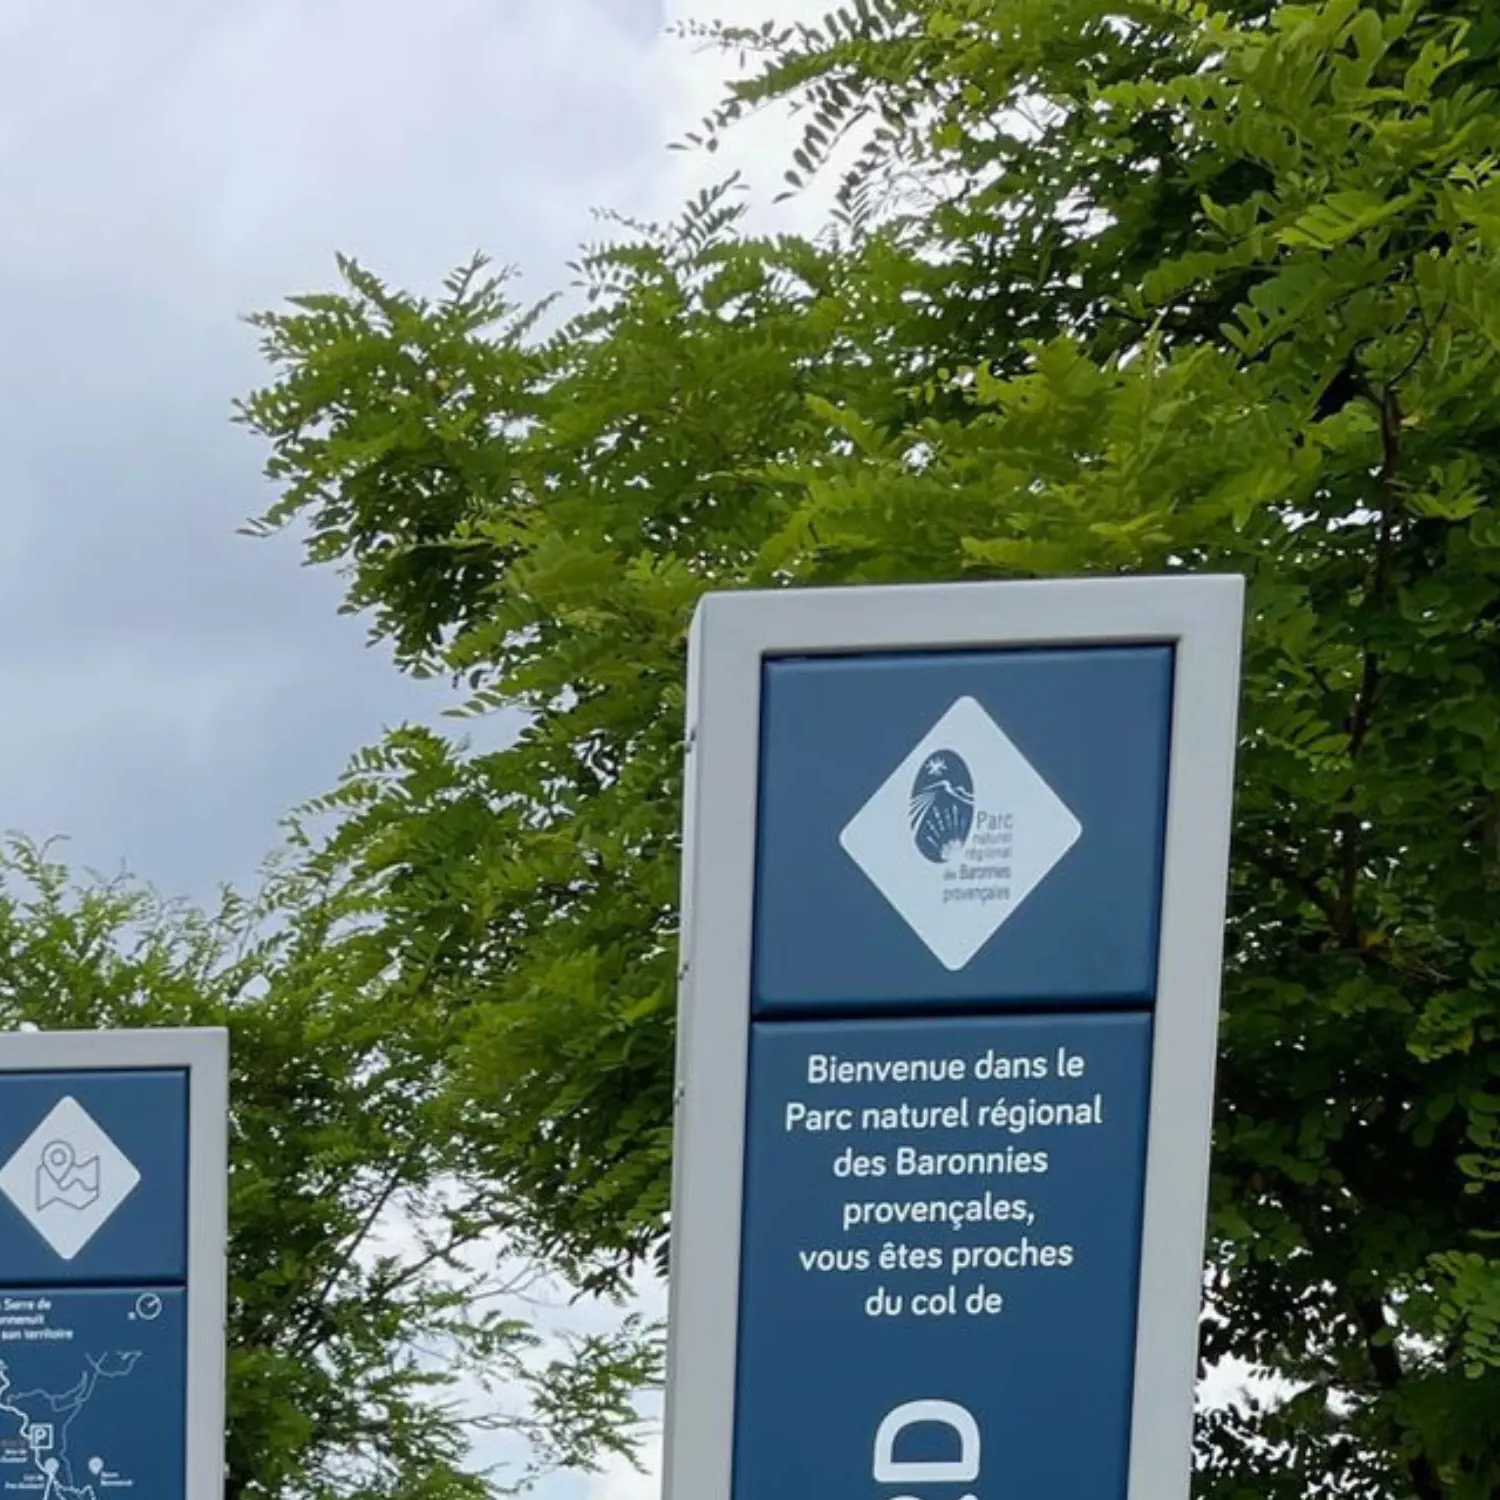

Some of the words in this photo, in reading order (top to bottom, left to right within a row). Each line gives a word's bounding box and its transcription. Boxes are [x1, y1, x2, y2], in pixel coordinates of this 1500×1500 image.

[977, 811, 1013, 830] Parc
[806, 1053, 967, 1084] Bienvenue
[974, 1049, 1048, 1079] dans
[1057, 1047, 1086, 1077] le
[785, 1102, 852, 1132] Parc
[861, 1097, 969, 1129] naturel
[977, 1094, 1103, 1133] régional
[833, 1147, 886, 1177] des
[896, 1145, 1049, 1176] Baronnies
[843, 1191, 1036, 1231] provençales,
[799, 1246, 870, 1271] vous
[878, 1241, 943, 1270] êtes
[951, 1237, 1074, 1275] proches
[864, 1286, 902, 1316] du
[911, 1286, 957, 1315] col
[965, 1284, 1004, 1314] de
